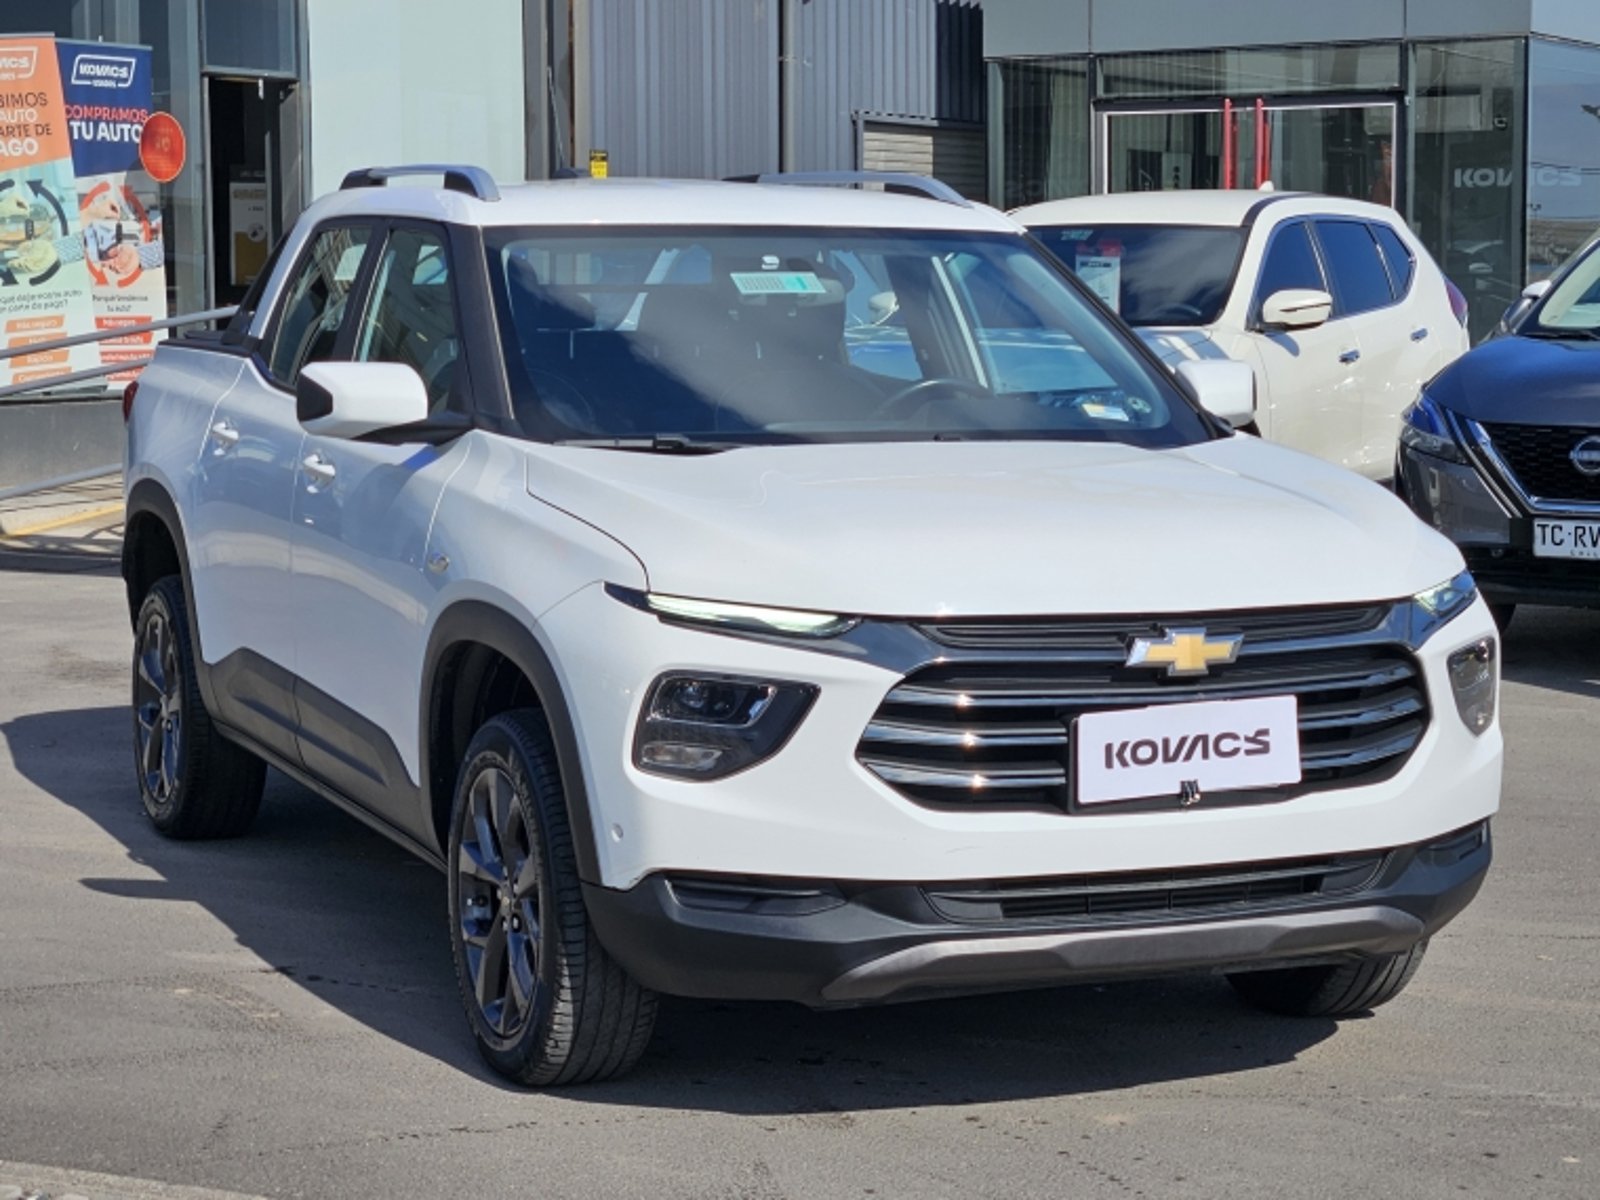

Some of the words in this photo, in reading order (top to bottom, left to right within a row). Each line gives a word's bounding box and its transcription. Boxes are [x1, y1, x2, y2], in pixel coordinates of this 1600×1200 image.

[35, 123, 53, 136] DE
[69, 121, 94, 140] TU
[96, 121, 144, 143] AUTO
[1105, 728, 1270, 769] KOVACS
